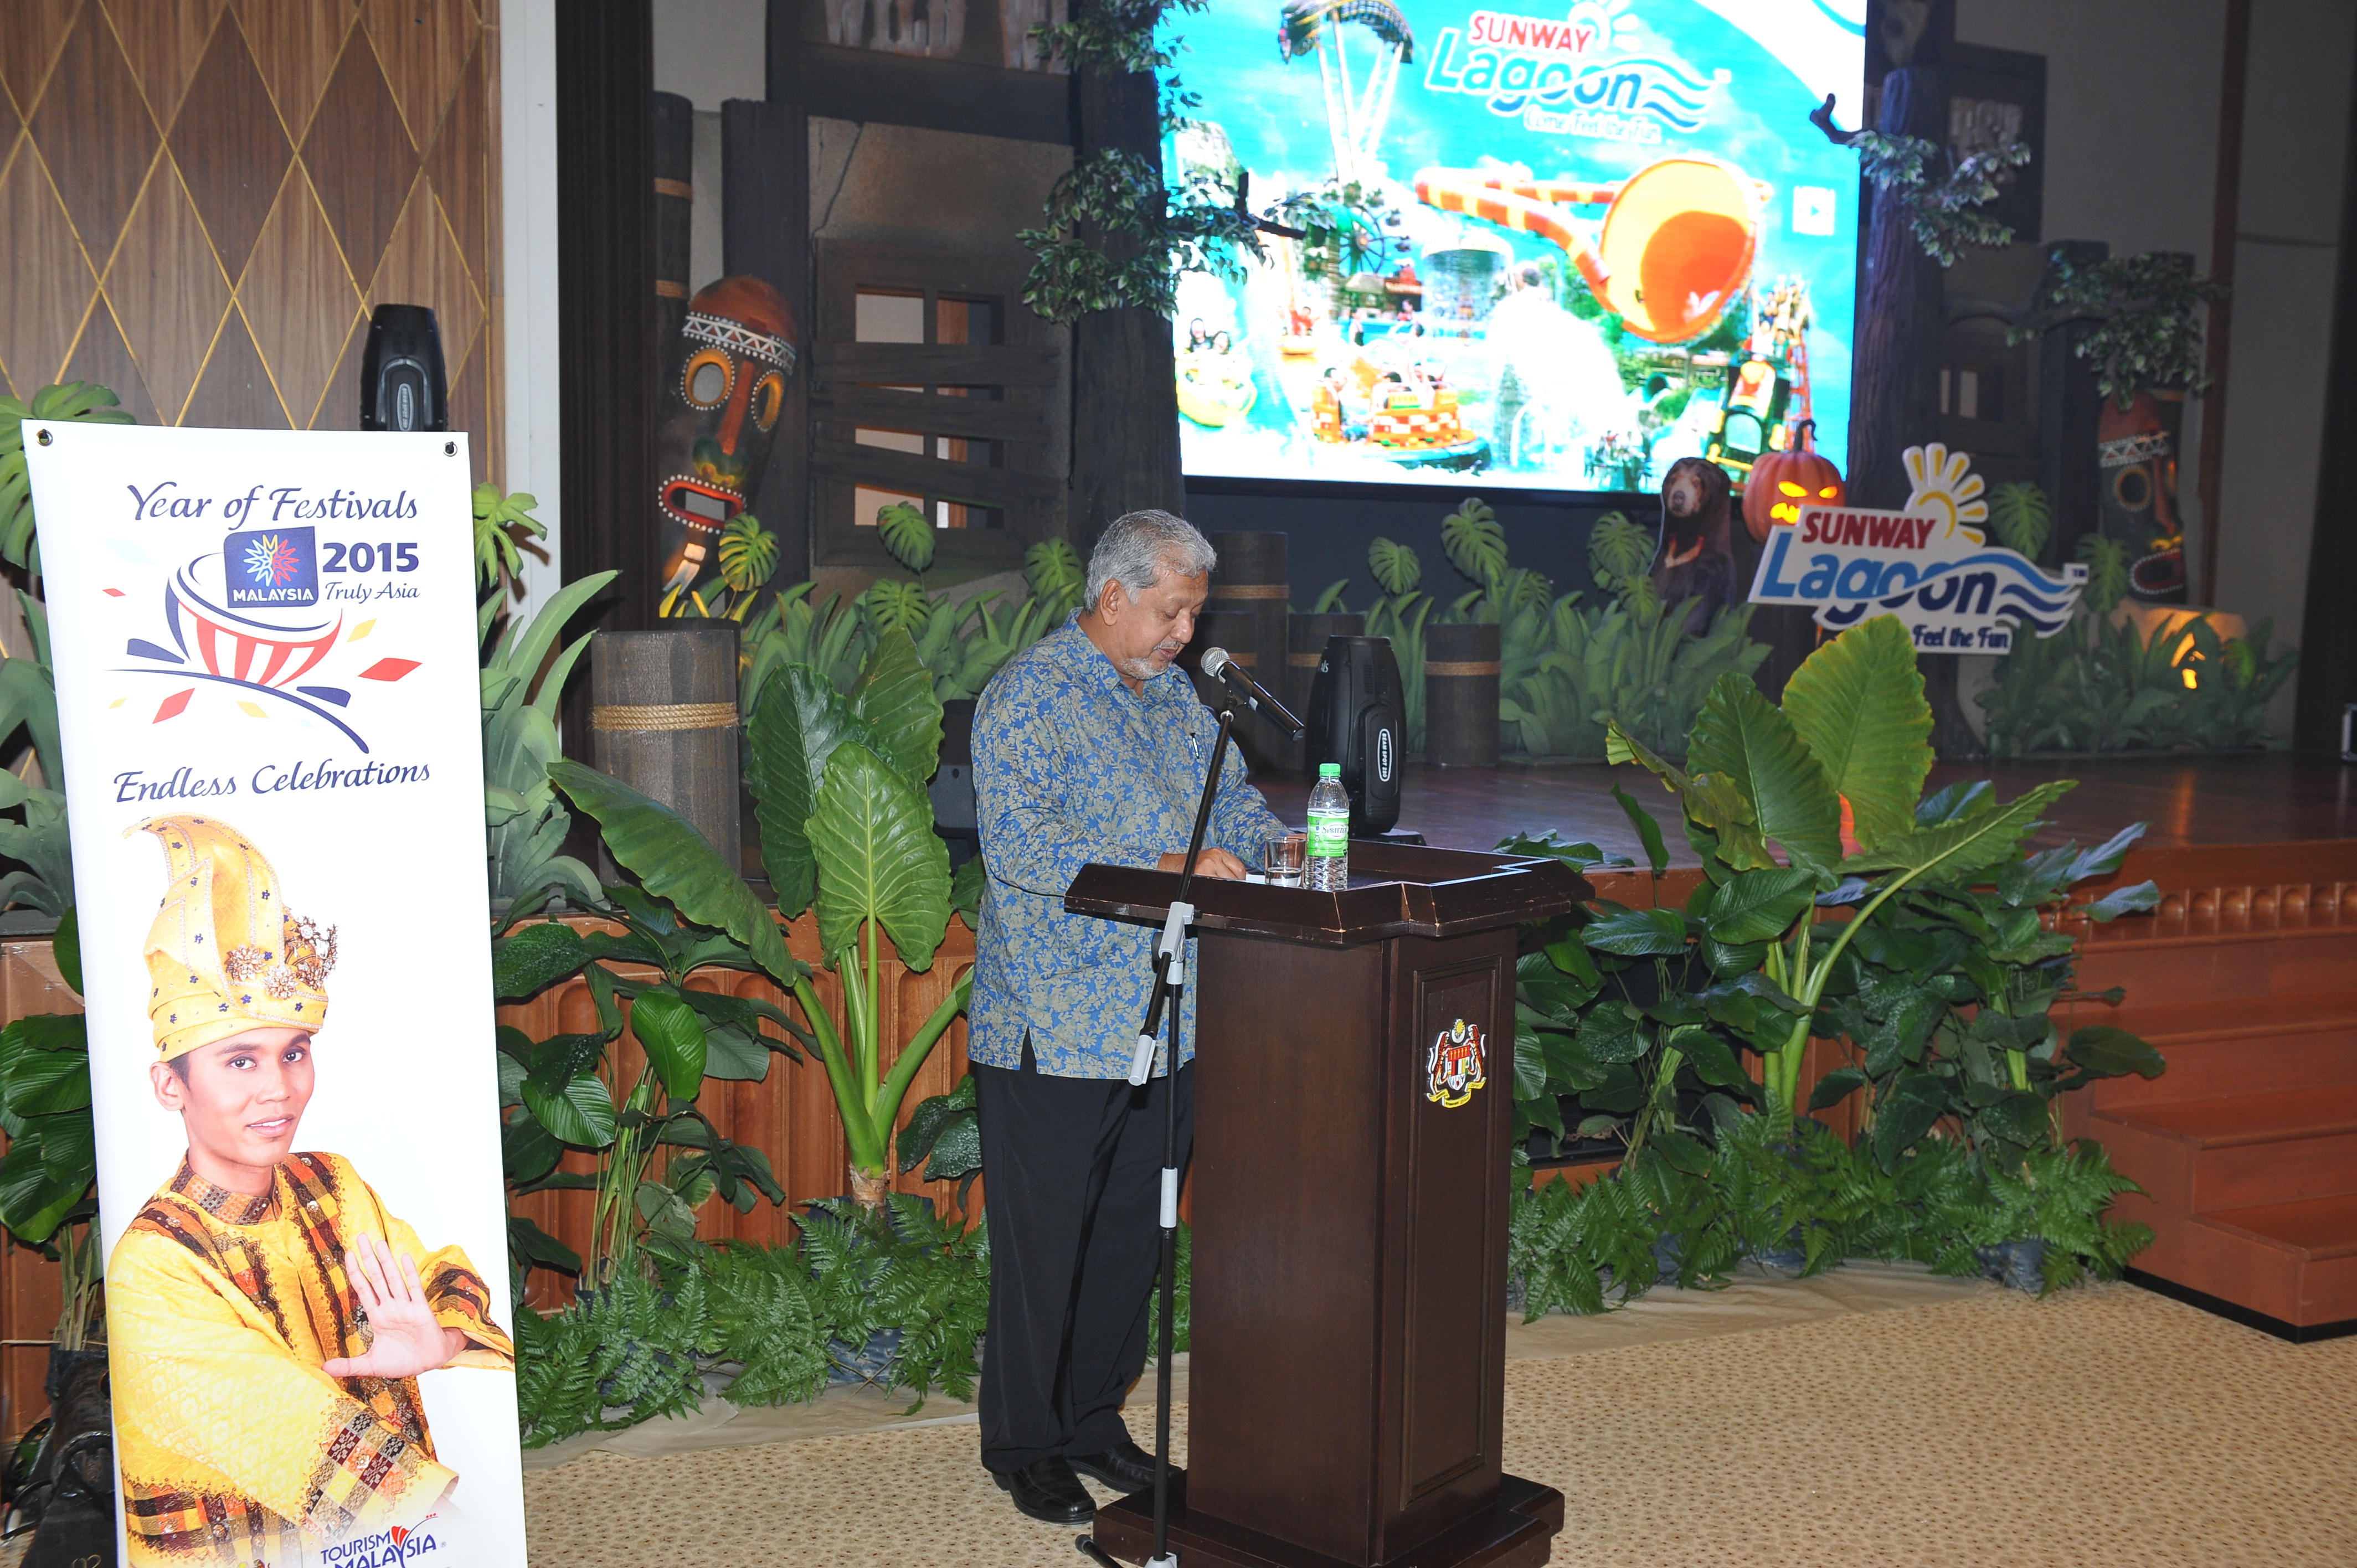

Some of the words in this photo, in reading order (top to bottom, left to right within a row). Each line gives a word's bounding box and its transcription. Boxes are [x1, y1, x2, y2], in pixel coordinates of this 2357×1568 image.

[1471, 15, 1591, 53] SUNWAY
[1428, 32, 1641, 111] Lagoon
[127, 481, 211, 521] Year
[223, 484, 264, 530] of
[269, 487, 418, 521] Festivals
[1802, 512, 1936, 549] SUNWAY
[322, 541, 420, 573] 2015
[233, 587, 315, 602] MALAYSIA
[325, 581, 374, 605] Truly
[374, 581, 421, 600] Asia
[1759, 532, 1998, 623] Lagoon
[1913, 624, 1947, 646] Feel
[1949, 627, 1974, 647] the
[1978, 627, 2009, 648] Fun
[114, 766, 238, 803] Endless
[251, 758, 430, 795] Celebrations
[320, 1530, 390, 1565] TOURISM
